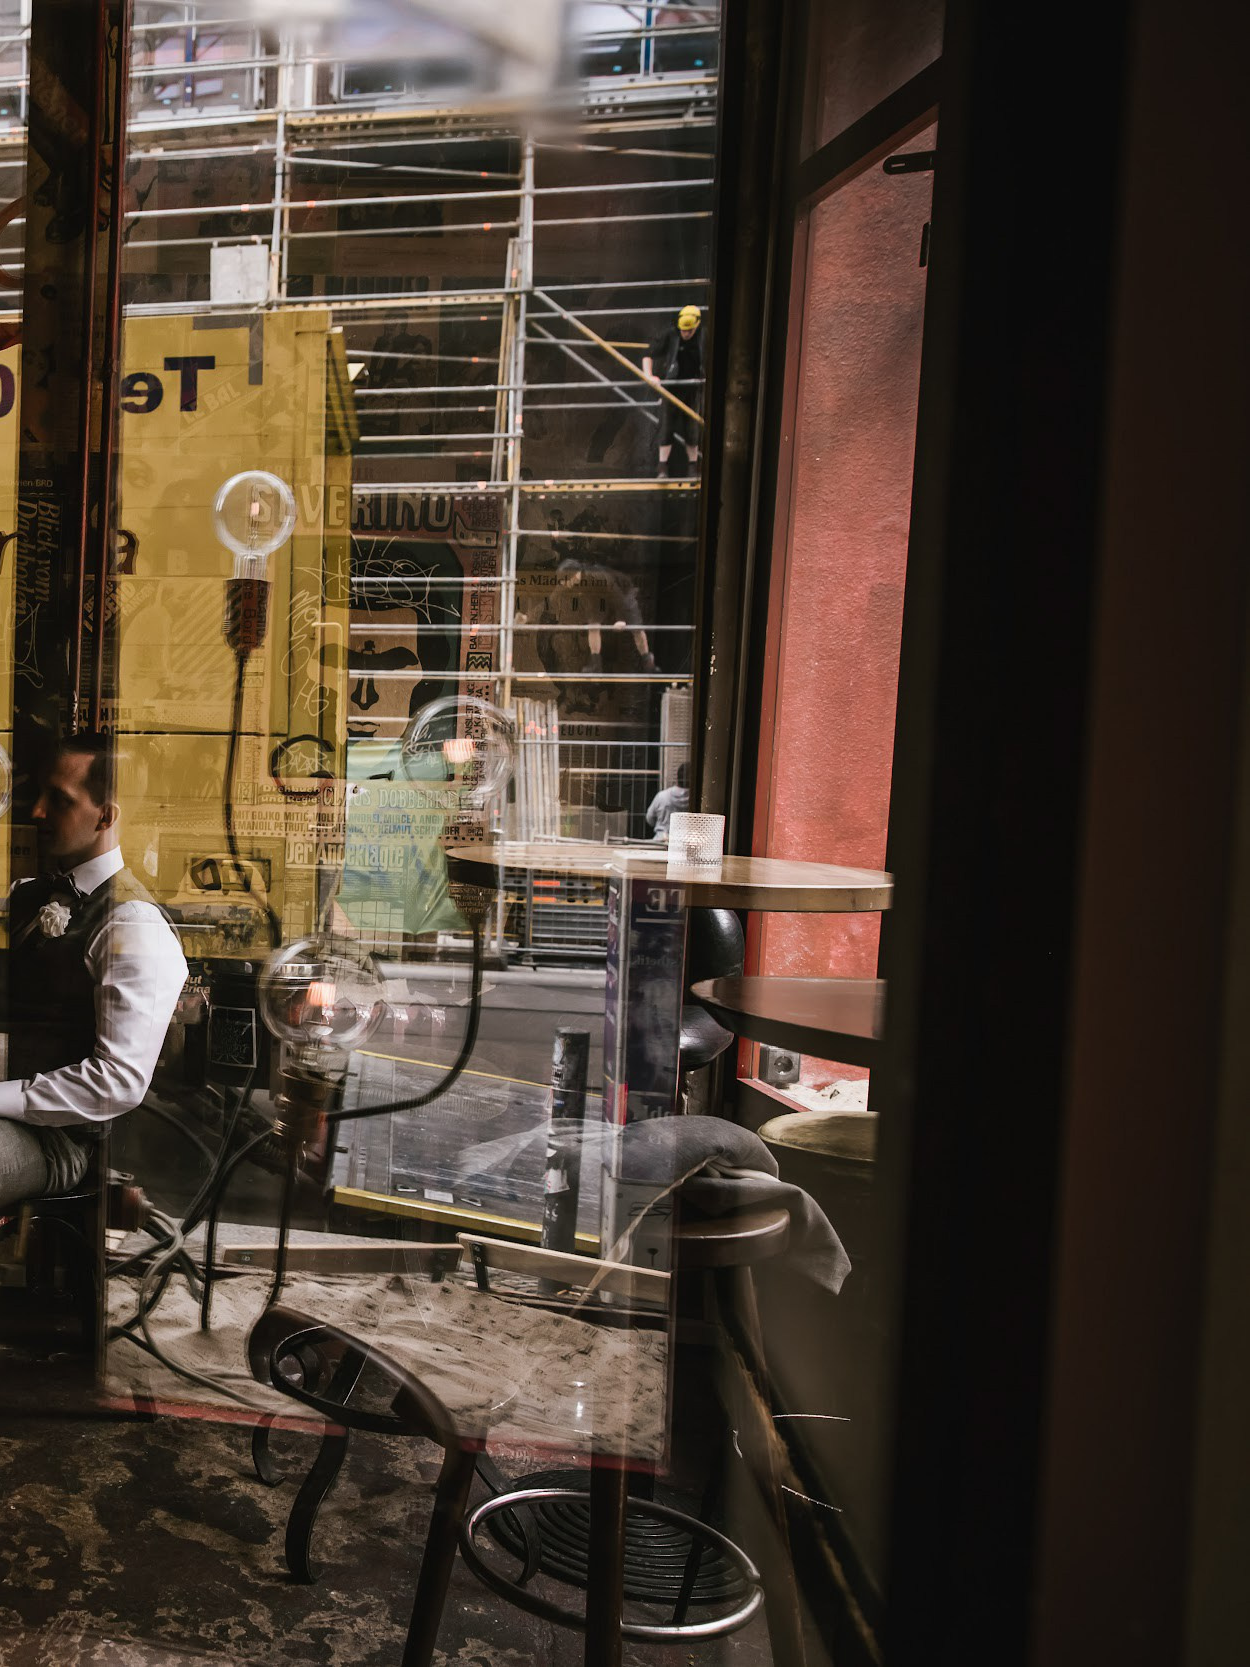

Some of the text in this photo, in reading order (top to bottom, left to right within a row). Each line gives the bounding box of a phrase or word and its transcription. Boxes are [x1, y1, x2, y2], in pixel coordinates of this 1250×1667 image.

[15, 499, 38, 616] Dachboden
[34, 499, 61, 602] Blick vom
[233, 810, 250, 821] MIT
[252, 811, 281, 821] GOJKO
[378, 788, 458, 809] DOBBERKE
